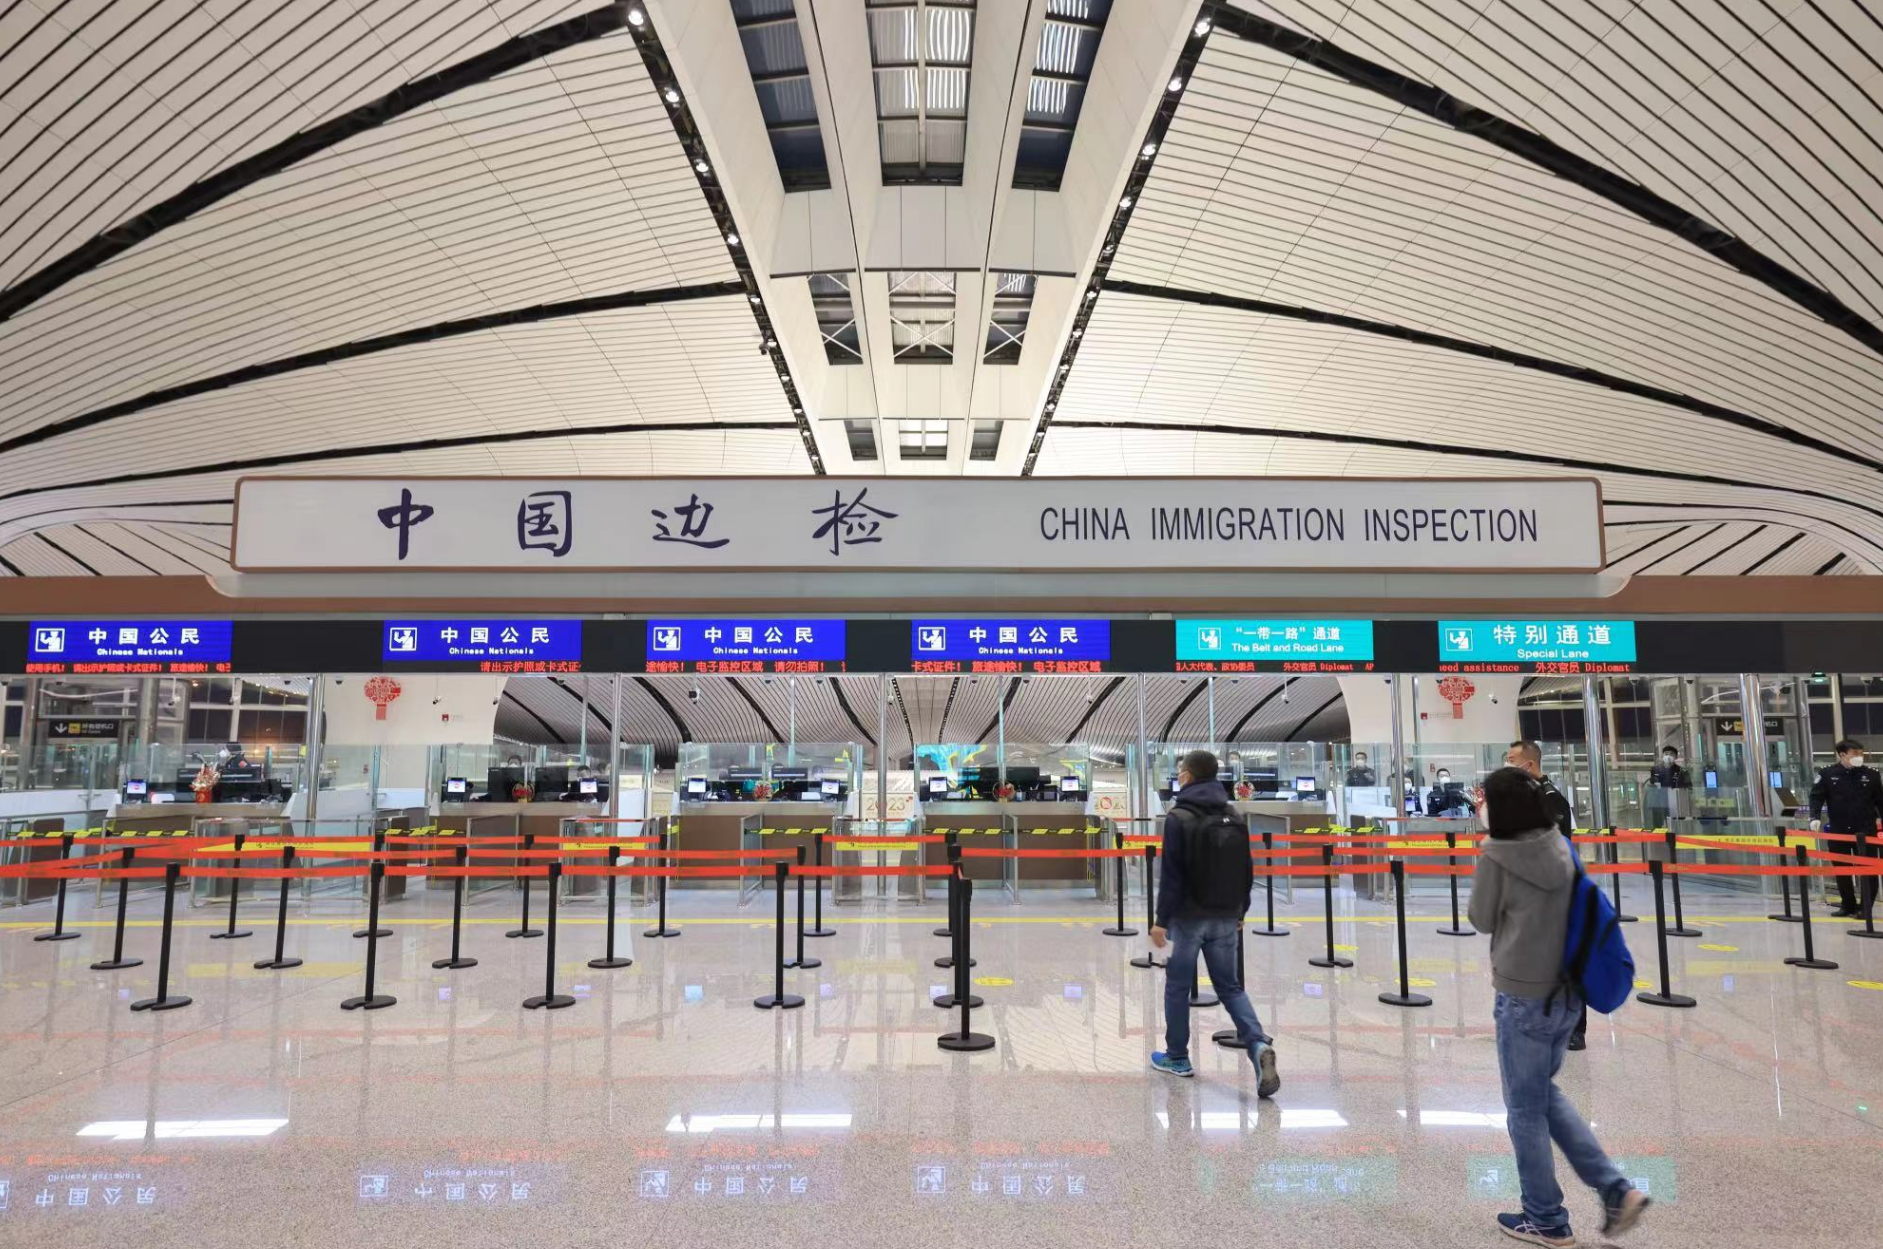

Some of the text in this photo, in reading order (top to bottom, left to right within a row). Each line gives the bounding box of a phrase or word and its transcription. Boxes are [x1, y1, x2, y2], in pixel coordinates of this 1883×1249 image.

[377, 487, 898, 557] 中国边检
[1040, 507, 1537, 542] CHINA IMMIGRATION INSPECTION
[88, 627, 200, 645] 中国公民
[440, 626, 550, 644] 中国公民
[704, 626, 814, 644] 中国公民
[969, 626, 1079, 644] 中国公民
[1493, 624, 1611, 645] 特别通道
[96, 648, 184, 656] Chinese Nationals
[448, 647, 534, 655] Chinese Nationals
[712, 646, 798, 655] Chinese Nationals
[978, 646, 1063, 655] Chinese Nationals
[1232, 642, 1344, 653] The Belt and Road Lane
[1517, 648, 1589, 660] Special Lane
[481, 661, 581, 673] 请出示护照或卡式证
[1463, 662, 1520, 672] assistance
[1535, 661, 1580, 673] 外交官员
[1585, 662, 1630, 674] Diplomat
